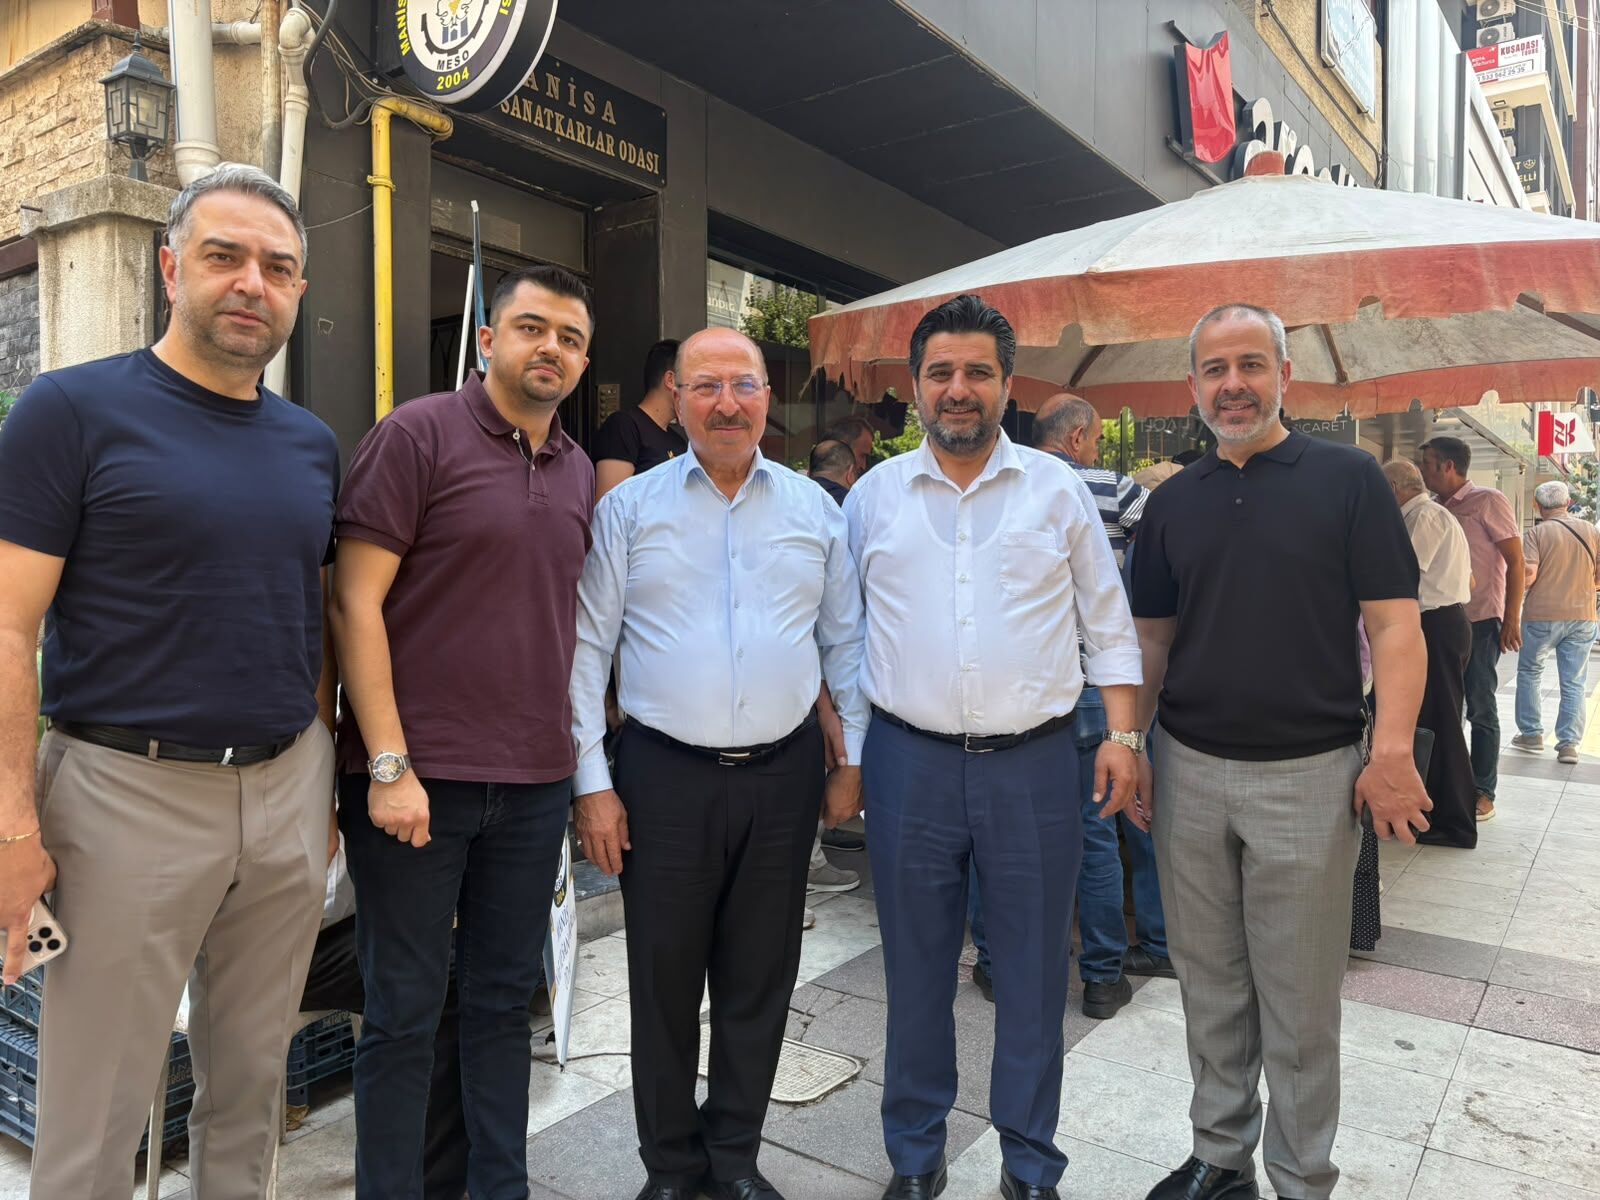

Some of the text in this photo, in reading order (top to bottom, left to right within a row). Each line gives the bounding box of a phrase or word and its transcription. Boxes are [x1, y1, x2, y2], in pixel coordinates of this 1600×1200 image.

[436, 50, 470, 71] MESO
[436, 66, 470, 90] 2004
[501, 94, 660, 175] SANATKARLAR ODASI
